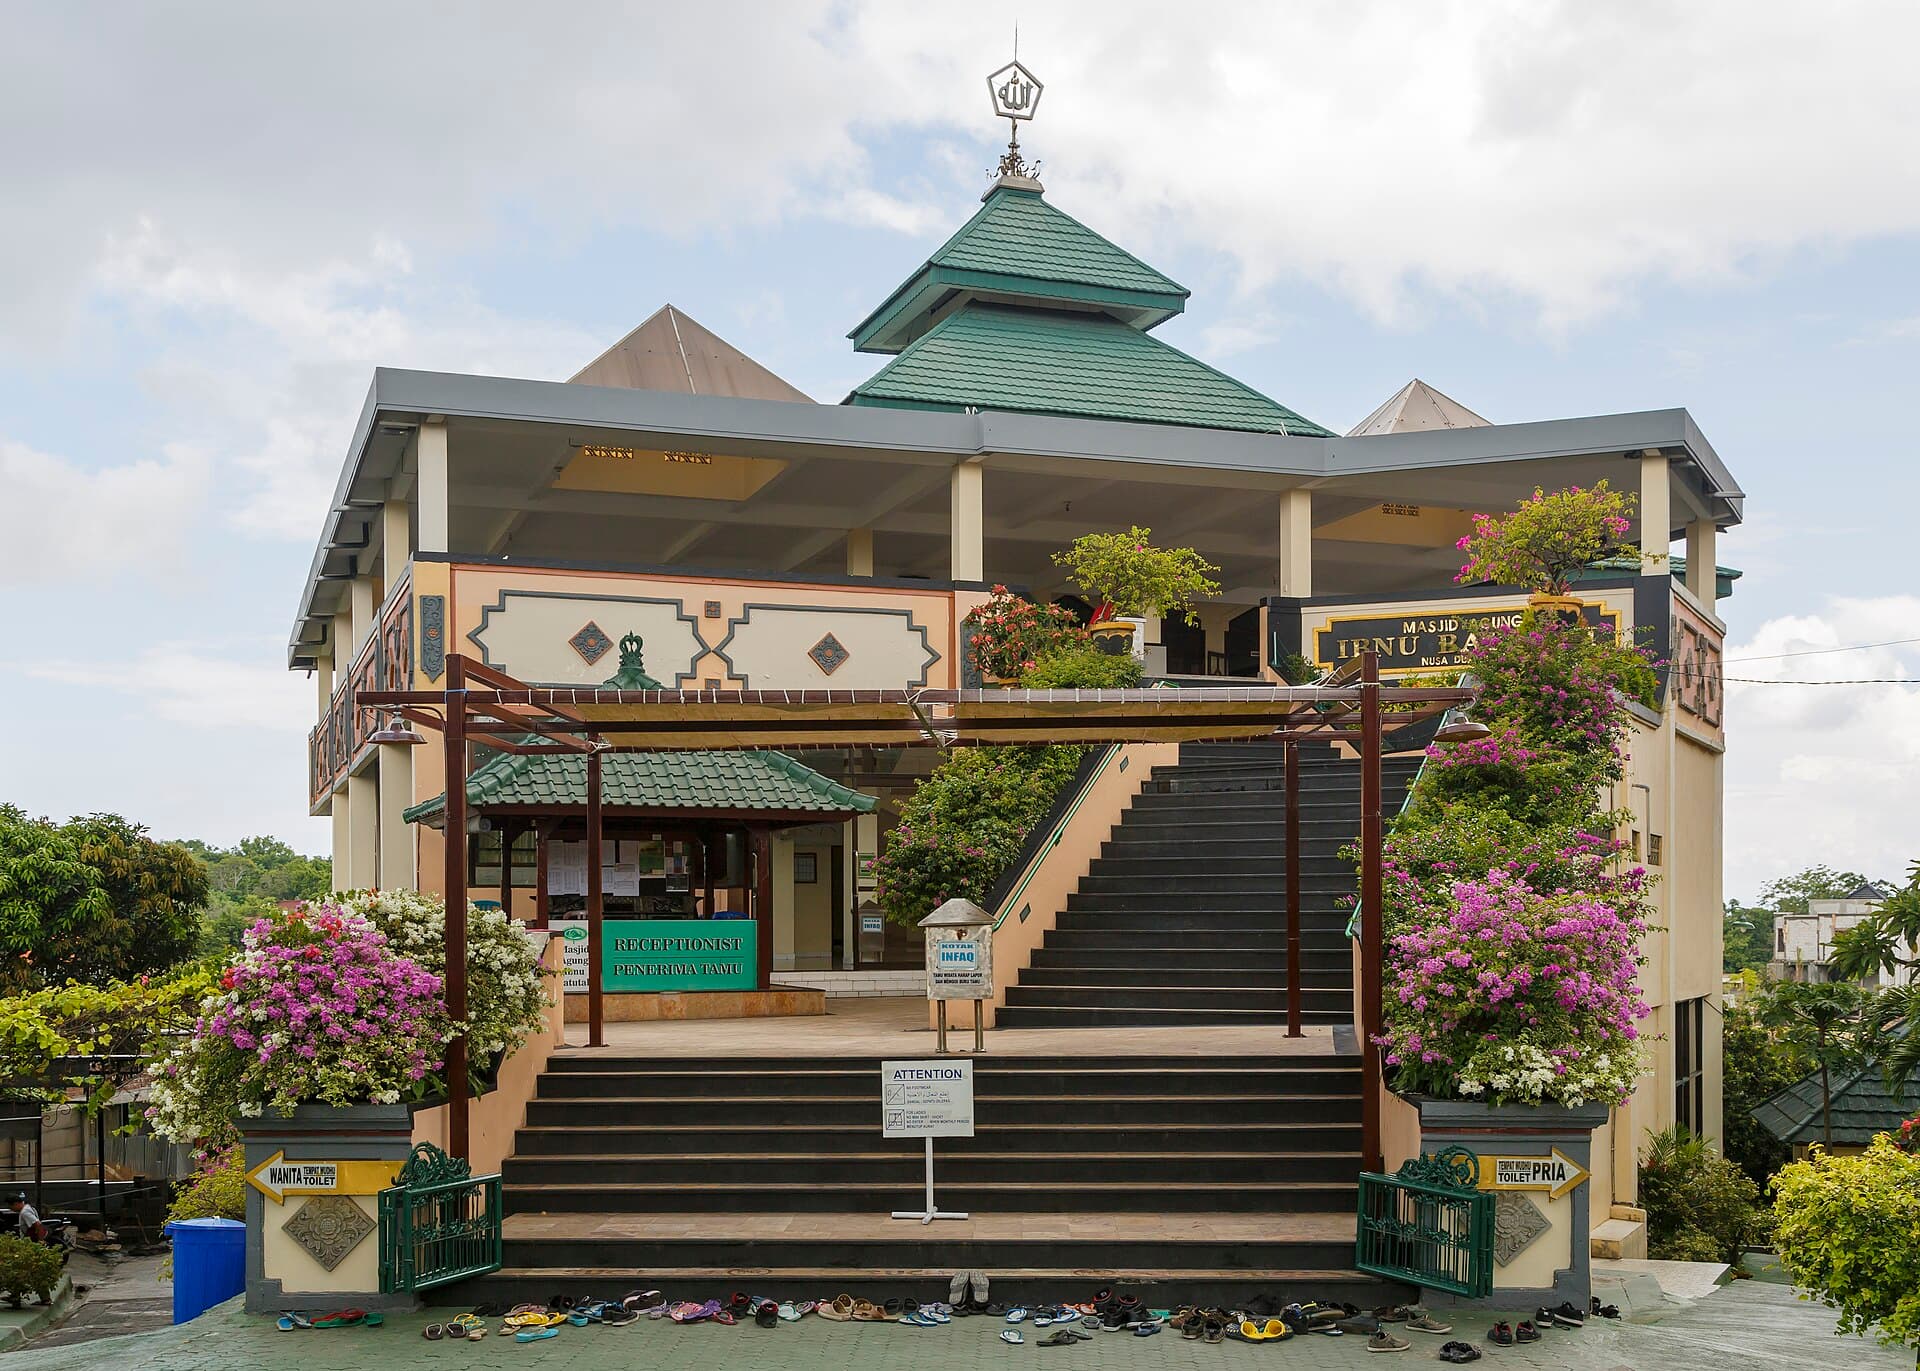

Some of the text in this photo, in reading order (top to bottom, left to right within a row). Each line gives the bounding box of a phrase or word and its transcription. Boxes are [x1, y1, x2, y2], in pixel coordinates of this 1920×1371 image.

[1402, 619, 1459, 634] MASJID
[1337, 636, 1420, 659] IBNU
[1421, 656, 1448, 666] NUSA
[615, 937, 743, 951] RECEPTIONIST
[941, 951, 975, 962] INFAQ
[614, 963, 743, 976] PENERIMA TAMU
[893, 1069, 962, 1080] ATTENTION
[270, 1167, 302, 1184] WANITA
[303, 1166, 319, 1175] TEMPAT
[1532, 1162, 1566, 1181] PRIA
[303, 1176, 336, 1186] TOILET
[1498, 1172, 1531, 1182] TOILET
